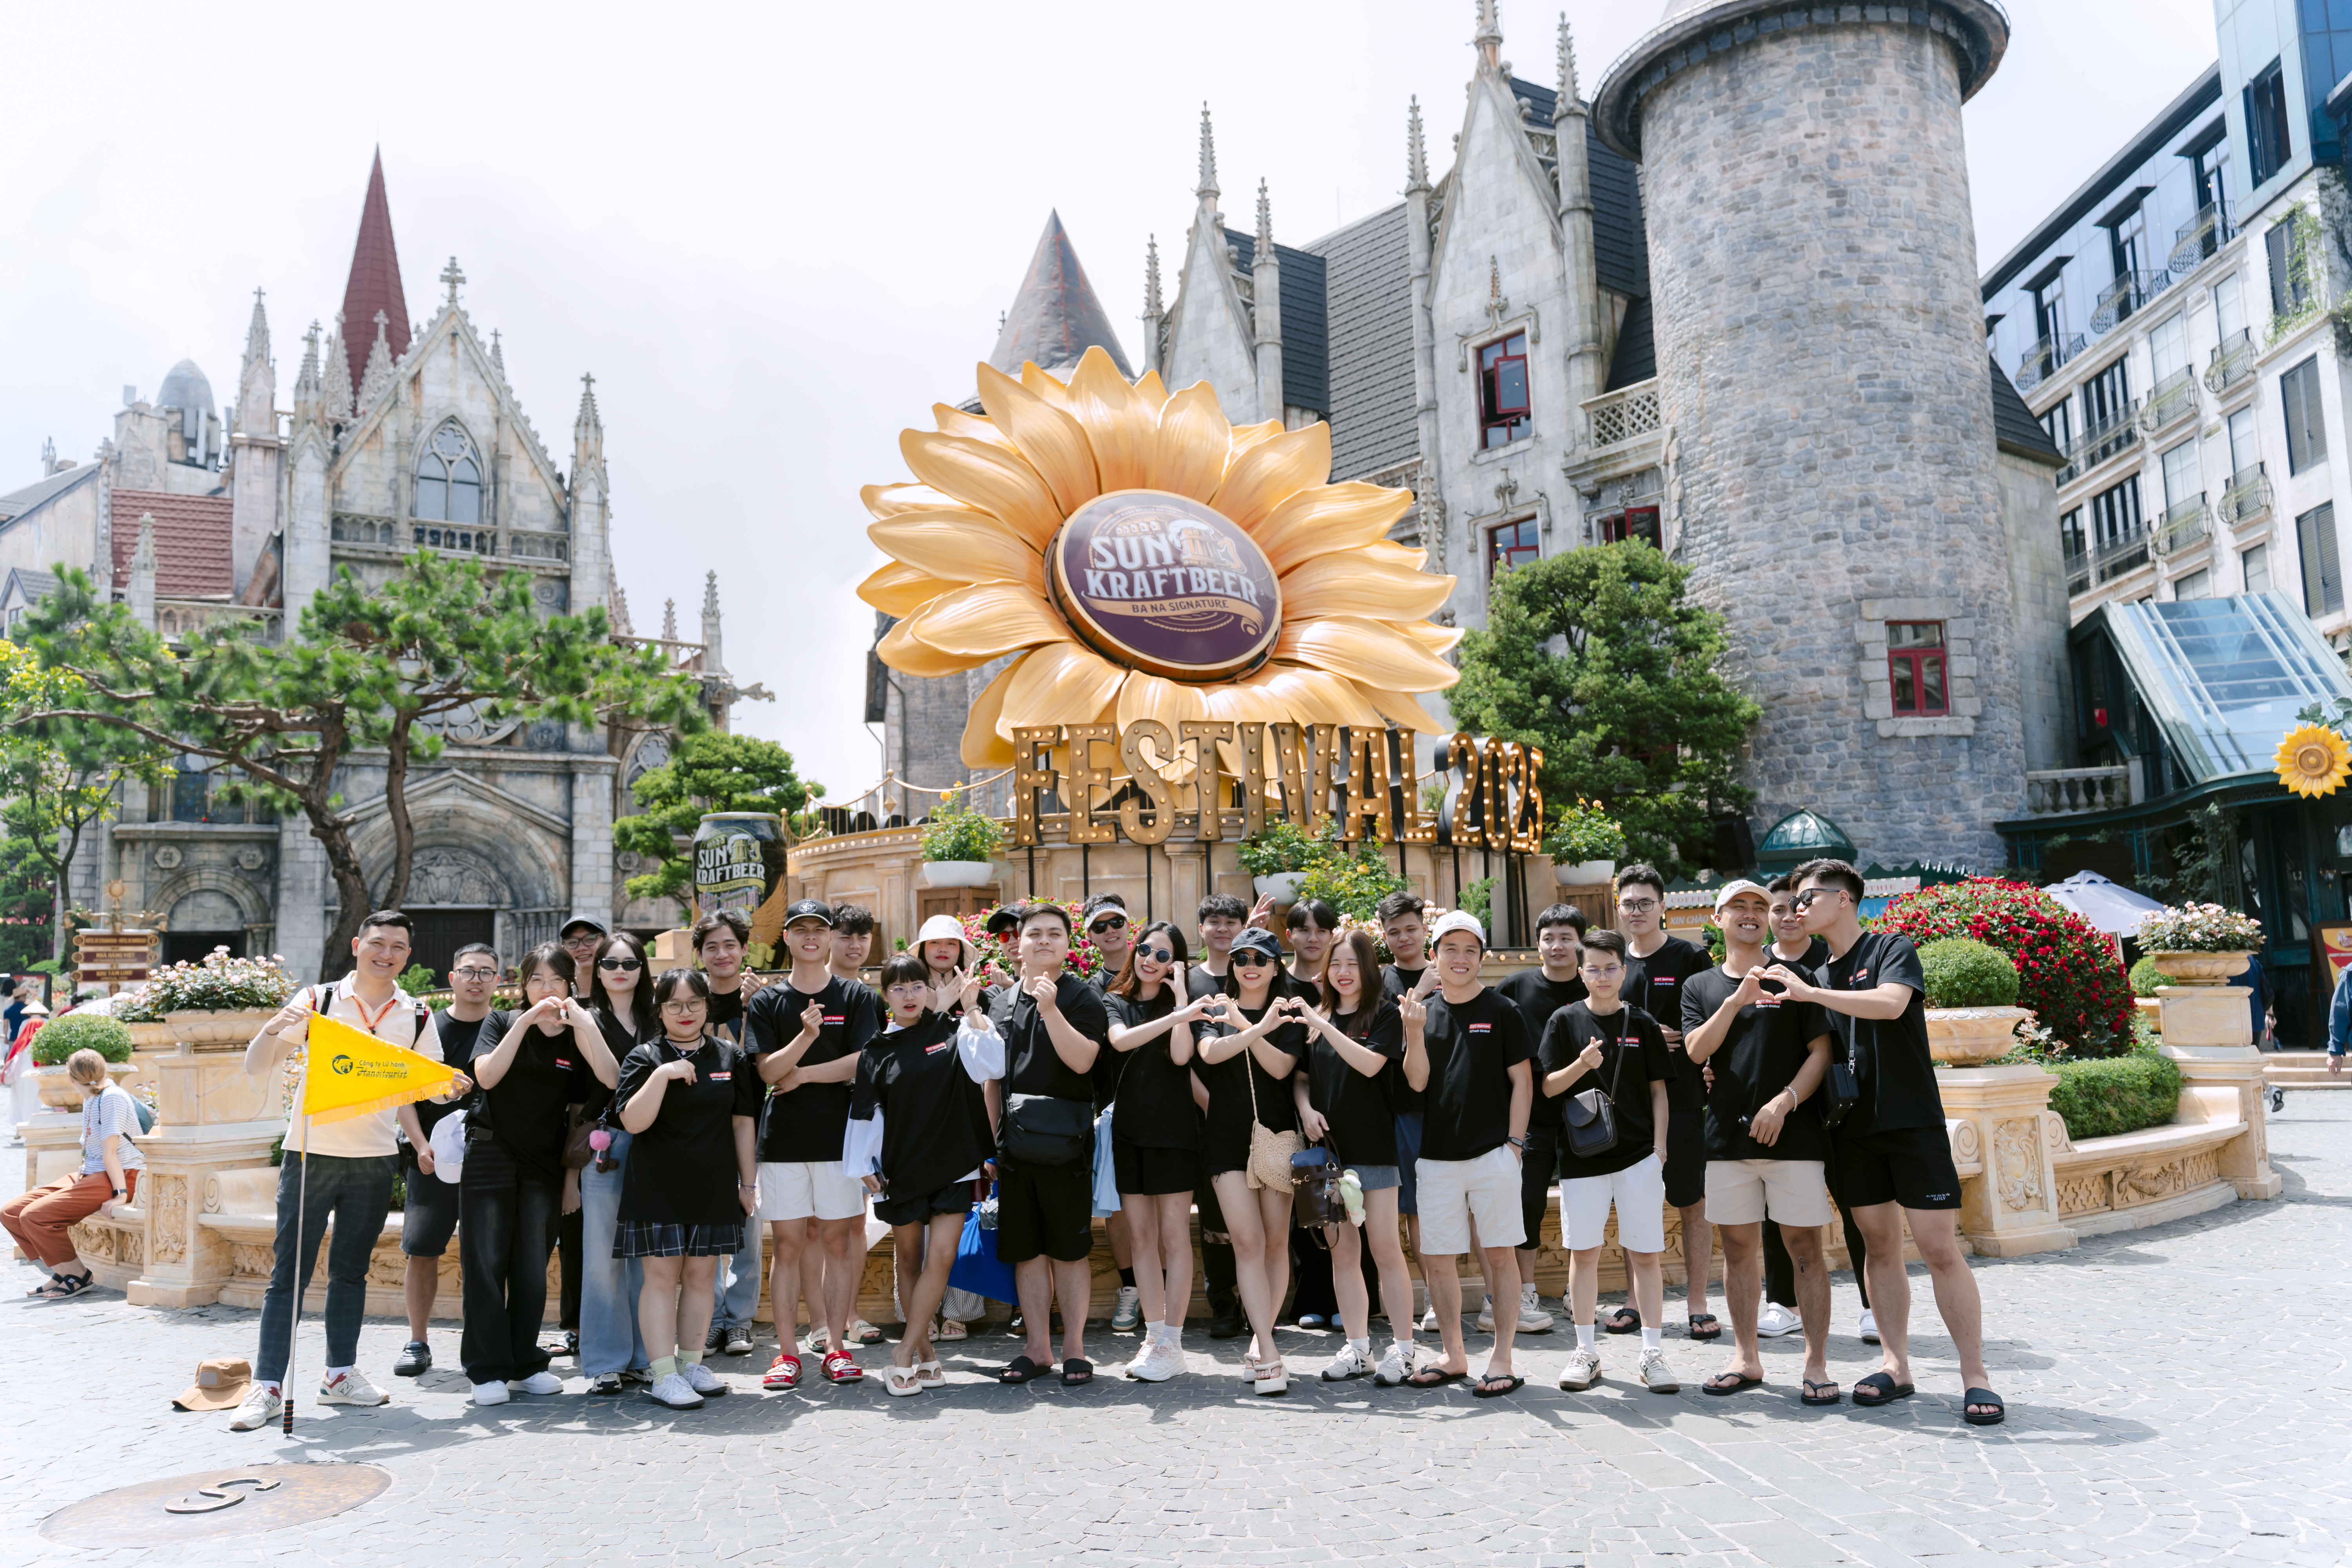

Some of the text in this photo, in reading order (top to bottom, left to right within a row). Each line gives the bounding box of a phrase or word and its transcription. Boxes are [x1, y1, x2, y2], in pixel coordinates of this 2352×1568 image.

[1090, 533, 1176, 570] SUN
[1083, 566, 1261, 607] KRAFTBEER
[1132, 599, 1229, 613] BA NA SIGNATURE
[1011, 719, 1437, 846] FESTIVAL
[698, 846, 728, 869] SUN
[696, 862, 765, 884] KRAFTBEER
[721, 879, 749, 889] SIGNATURE
[1670, 913, 1709, 924] XIN CHÀO
[356, 1067, 408, 1078] Hanoitourist
